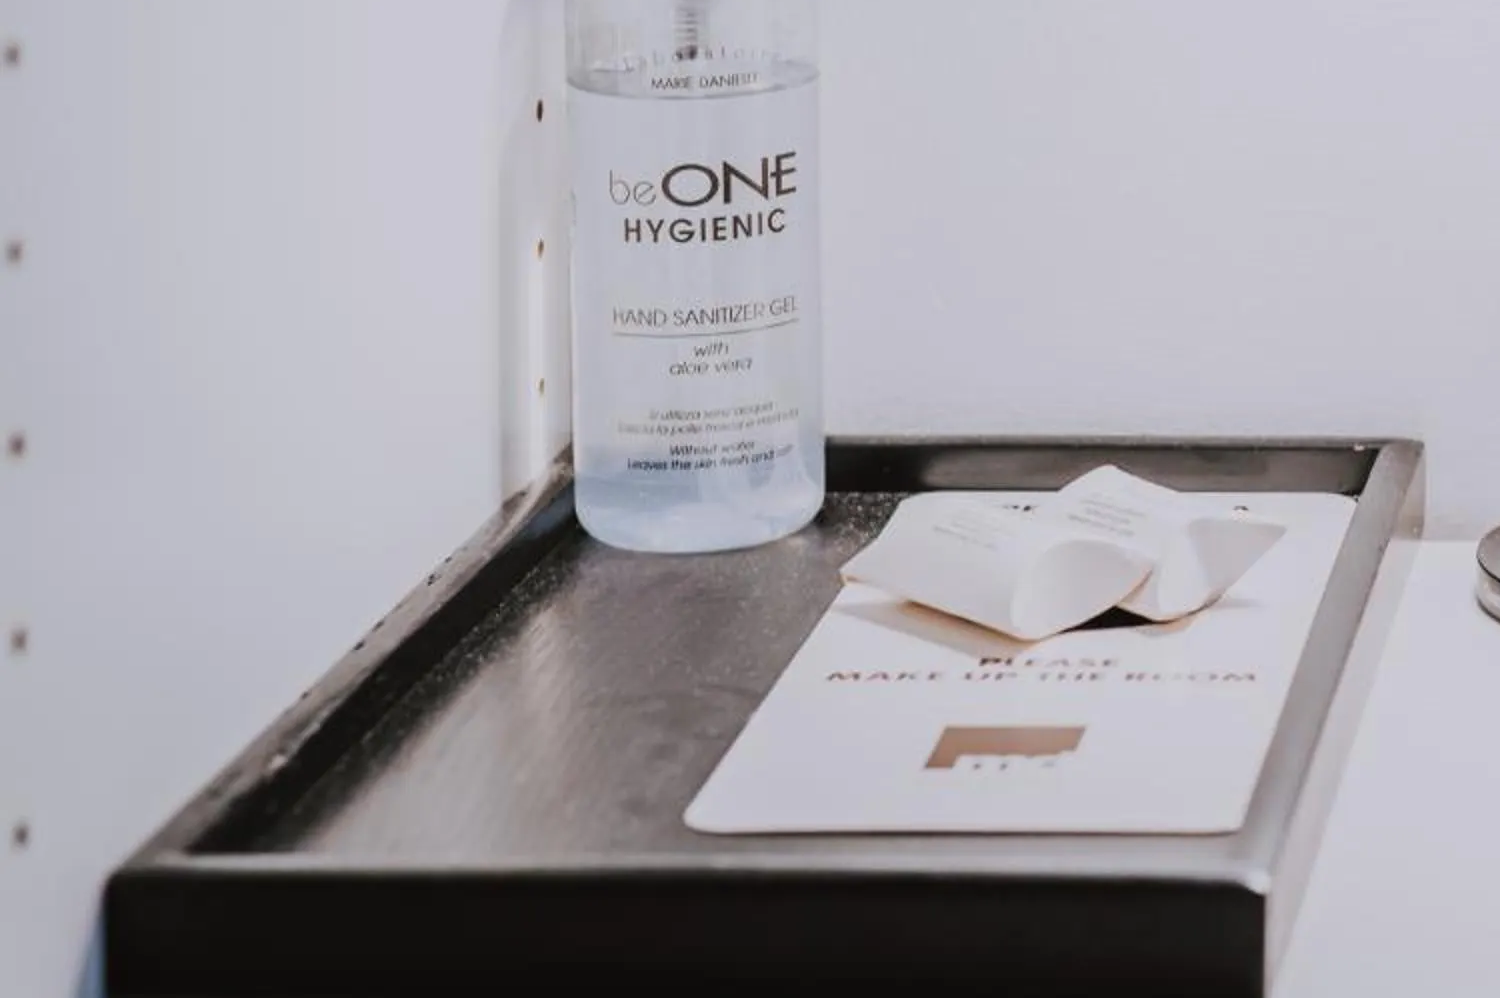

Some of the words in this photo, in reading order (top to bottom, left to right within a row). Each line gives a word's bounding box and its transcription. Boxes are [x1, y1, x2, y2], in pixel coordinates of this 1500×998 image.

[624, 208, 786, 243] HYGIENIC
[613, 305, 667, 327] HAND
[673, 303, 764, 326] SANITIZER
[768, 295, 799, 315] GEL
[979, 656, 1120, 667] PLEASE
[826, 670, 944, 681] MAKE
[1037, 670, 1107, 681] THE
